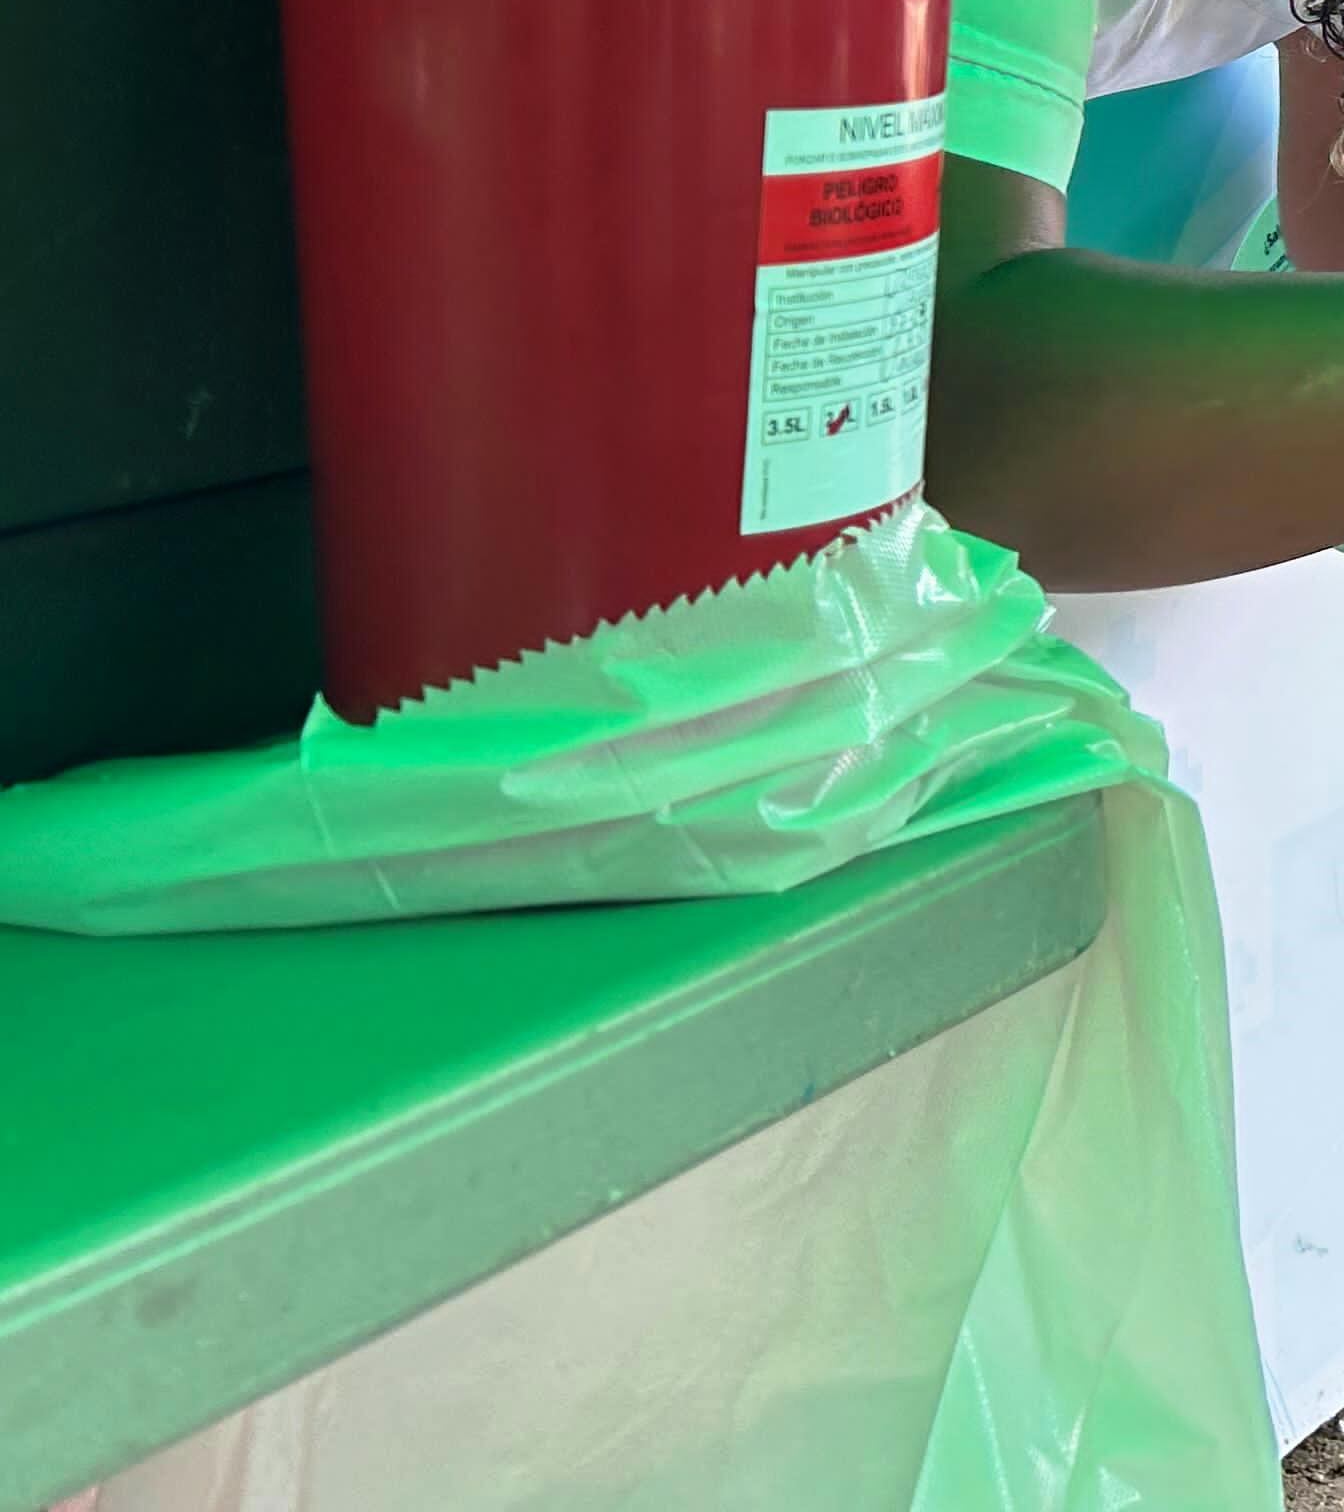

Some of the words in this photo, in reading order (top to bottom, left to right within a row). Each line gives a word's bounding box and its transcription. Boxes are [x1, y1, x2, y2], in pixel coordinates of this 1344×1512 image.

[839, 112, 905, 144] NIVEL
[822, 174, 898, 201] PELIGRO
[809, 196, 905, 228] BIOLÓGICO
[767, 416, 806, 437] 3.5L
